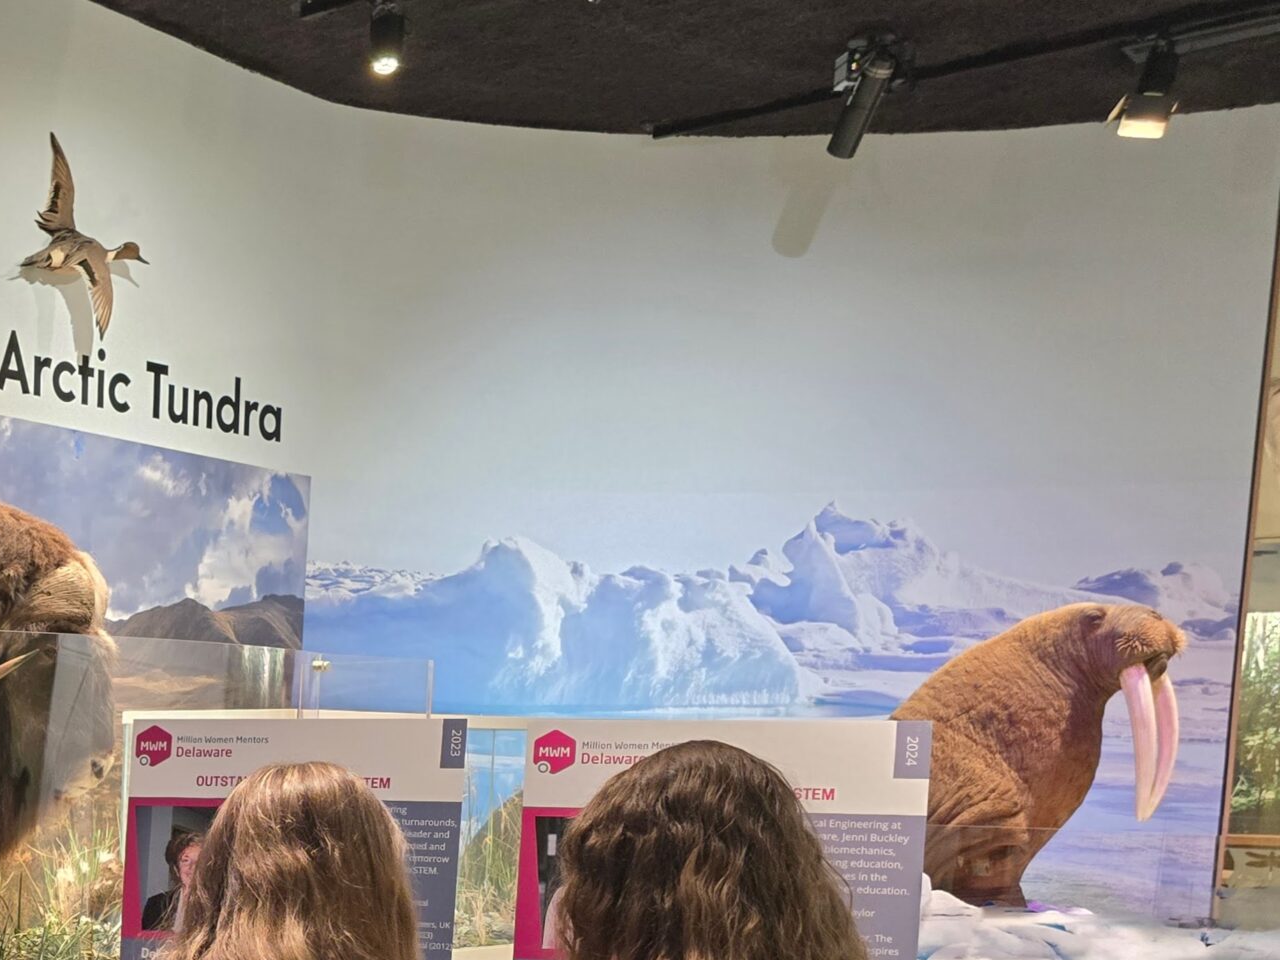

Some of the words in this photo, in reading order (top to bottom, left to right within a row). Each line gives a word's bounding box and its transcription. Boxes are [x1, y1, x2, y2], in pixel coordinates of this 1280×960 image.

[146, 361, 282, 442] Tundra
[177, 735, 203, 744] Million
[204, 736, 234, 744] Women
[235, 736, 269, 744] Mentors
[449, 729, 462, 757] 2023
[582, 741, 612, 750] Million
[614, 741, 649, 750] Women
[140, 740, 168, 752] MWM
[176, 746, 233, 758] Delaware
[538, 746, 571, 758] MWM
[905, 736, 919, 766] 2024
[363, 777, 391, 789] TEM
[793, 787, 835, 801] STEM
[402, 818, 458, 828] turnarounds,
[829, 819, 889, 832] Engineering
[891, 822, 902, 830] at
[433, 830, 450, 839] and
[840, 833, 868, 843] Jenni
[870, 834, 910, 845] Buckley
[428, 842, 446, 851] and
[824, 845, 896, 857] biomechanics,
[850, 859, 904, 871] education,
[858, 872, 868, 881] in
[870, 872, 888, 882] the
[856, 886, 910, 896] education.
[439, 921, 451, 929] UK
[874, 934, 893, 943] The
